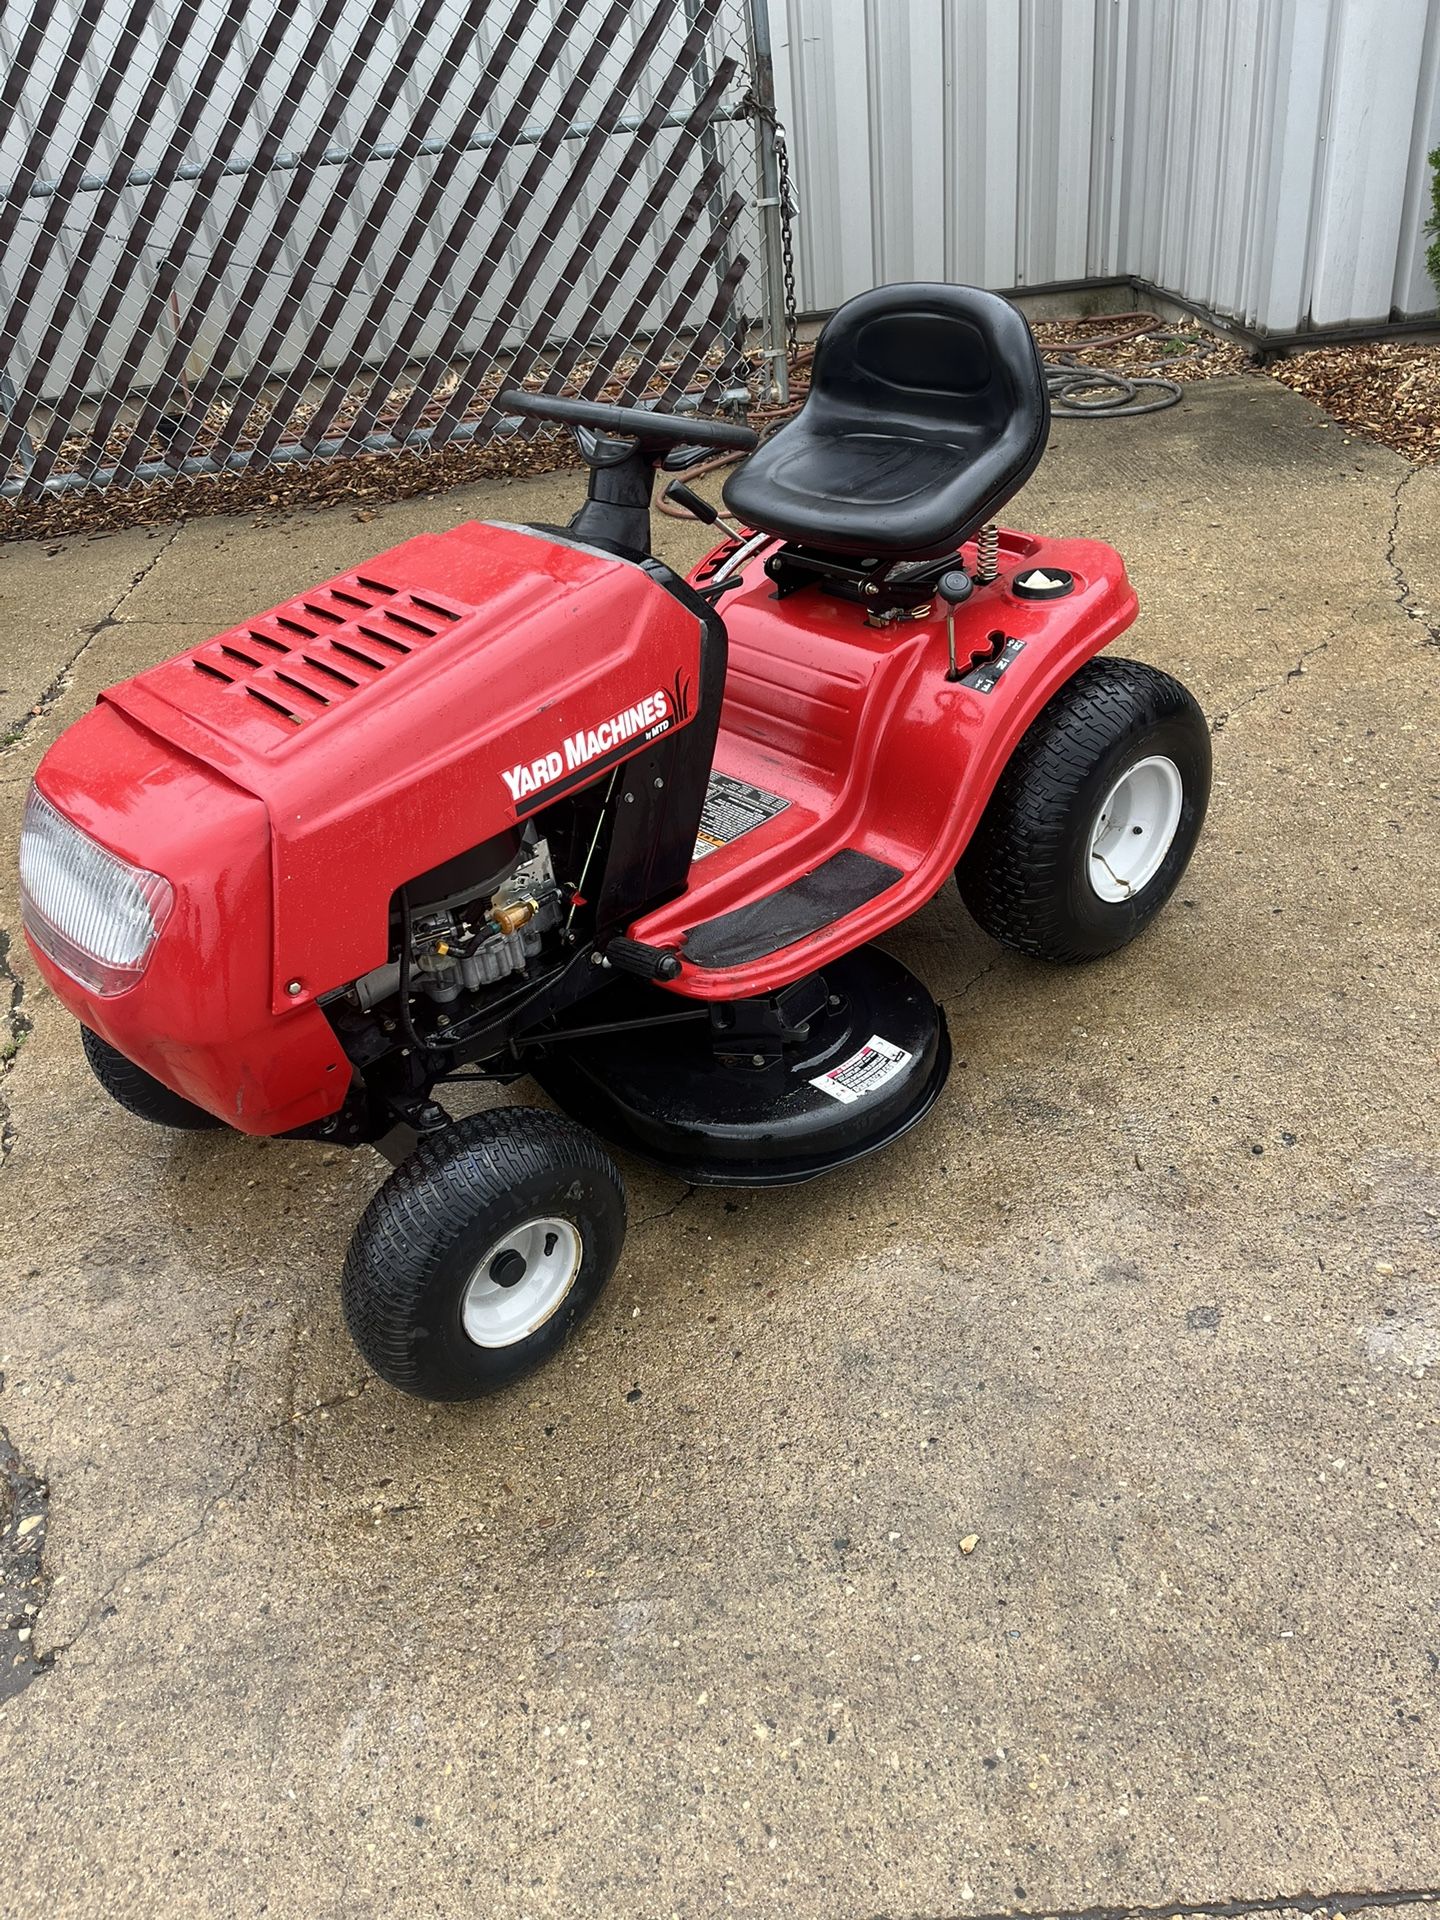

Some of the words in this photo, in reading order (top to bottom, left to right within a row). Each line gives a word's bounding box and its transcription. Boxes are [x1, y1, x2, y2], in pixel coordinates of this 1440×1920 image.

[996, 661, 1007, 670] N
[645, 731, 652, 741] by
[651, 720, 669, 738] MTD
[502, 752, 563, 800] YARD
[564, 691, 667, 769] MACHINES
